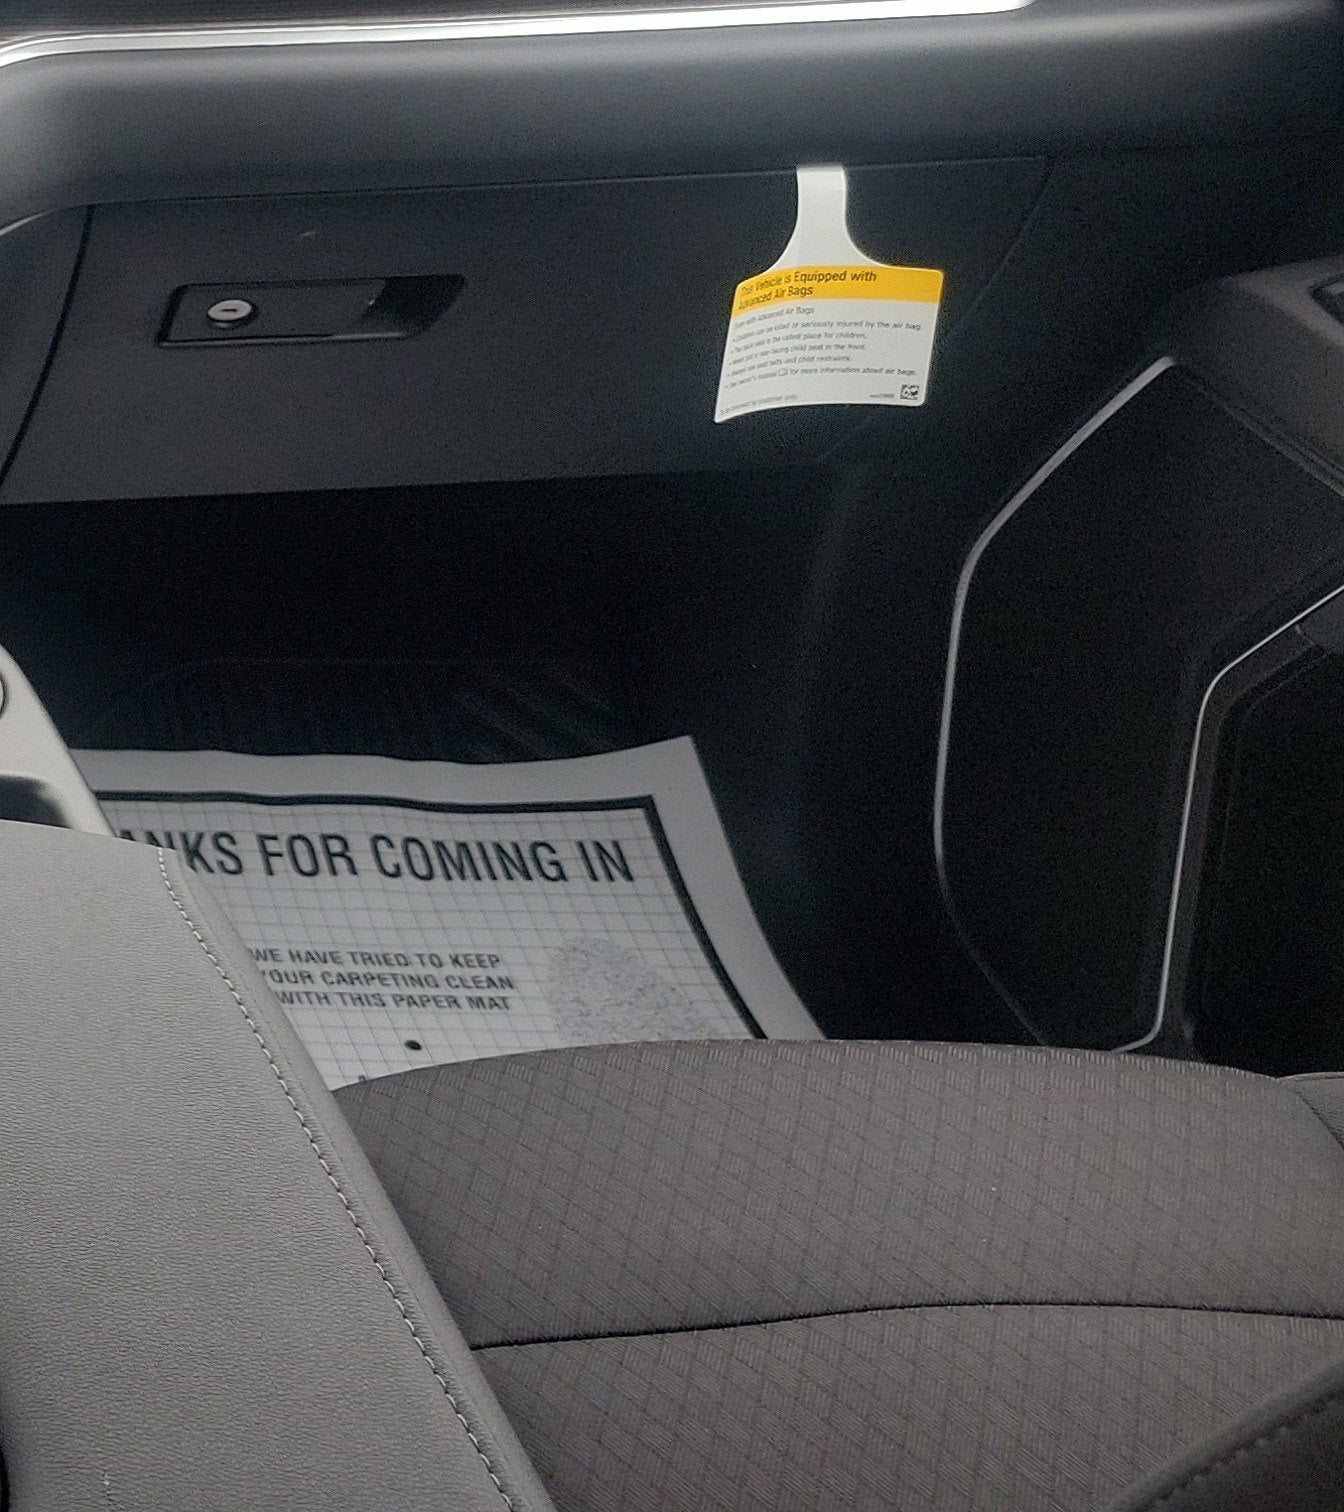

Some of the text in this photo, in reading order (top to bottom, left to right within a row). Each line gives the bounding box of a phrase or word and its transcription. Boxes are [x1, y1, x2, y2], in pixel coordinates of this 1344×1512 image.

[755, 277, 783, 292] Vehicle
[794, 270, 847, 284] Equipped
[851, 270, 877, 282] with
[774, 288, 786, 299] Air
[788, 285, 813, 297] Bags
[256, 833, 359, 877] FOR
[369, 833, 567, 883] COMING
[575, 839, 634, 883] IN
[248, 947, 501, 970] WE HAVE TRIED TO KEEP
[320, 970, 440, 989] CARPETING
[444, 974, 514, 990] CLEAN
[275, 990, 512, 1011] WITH THIS PAPER MAT
